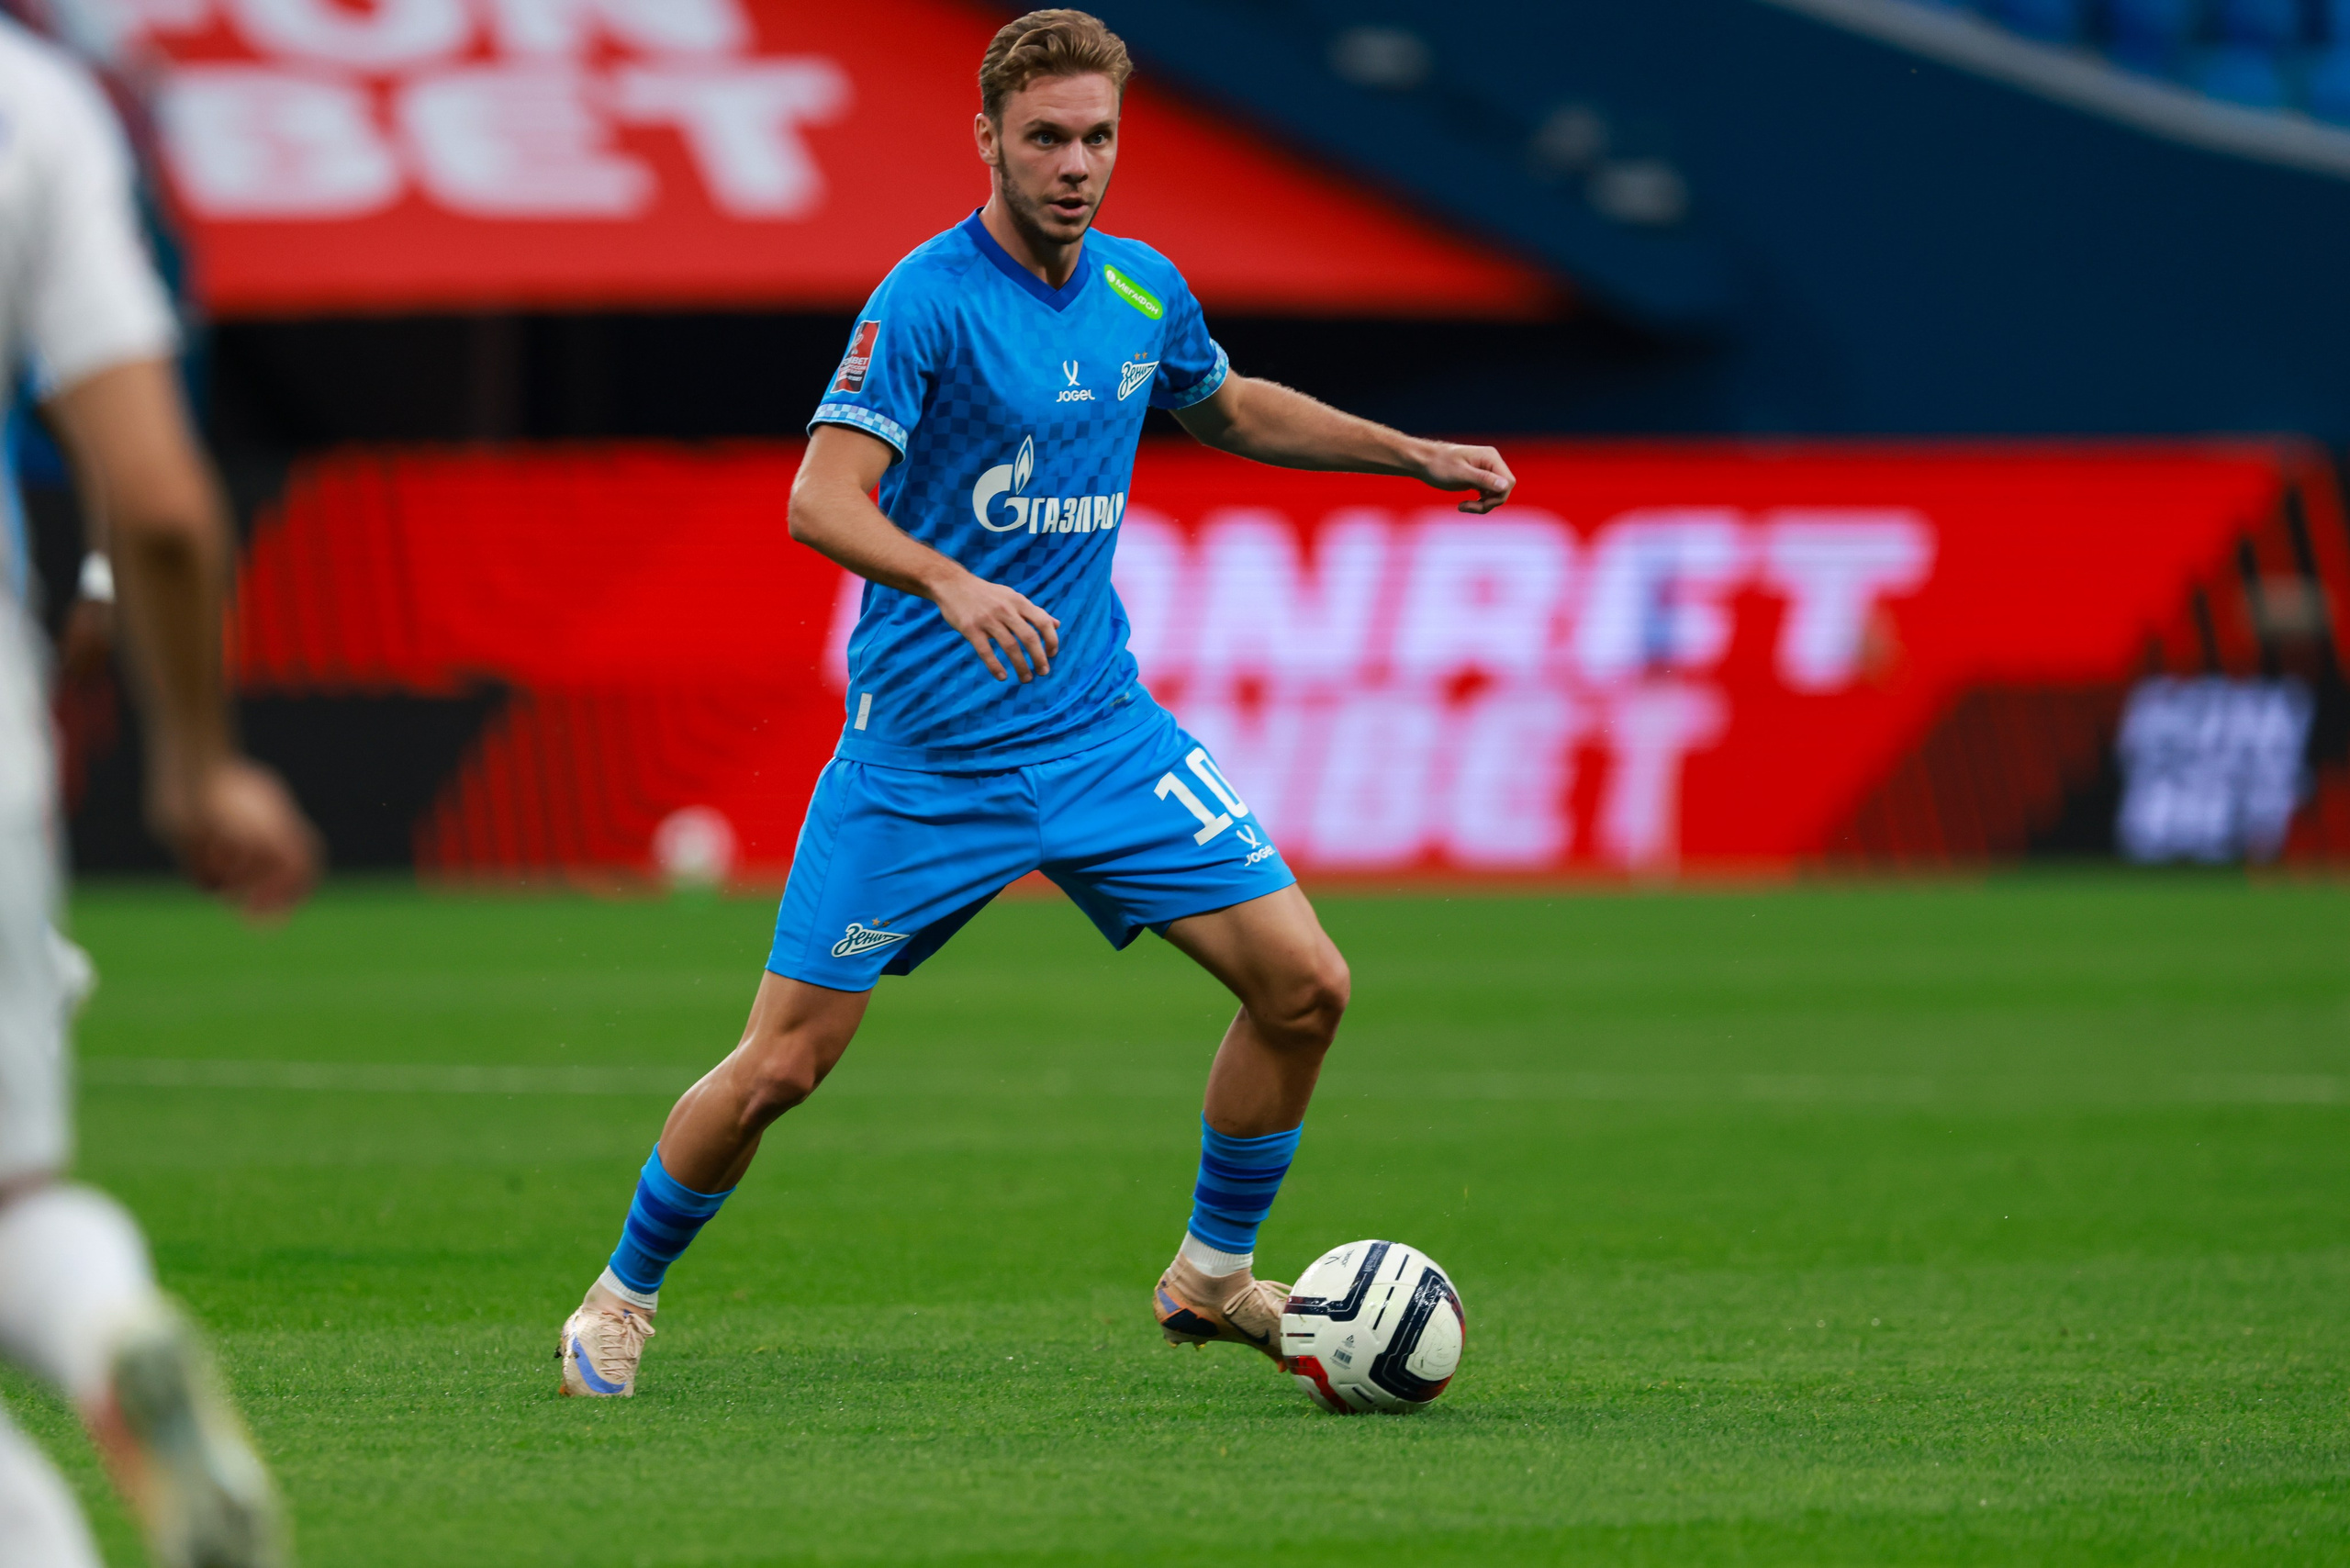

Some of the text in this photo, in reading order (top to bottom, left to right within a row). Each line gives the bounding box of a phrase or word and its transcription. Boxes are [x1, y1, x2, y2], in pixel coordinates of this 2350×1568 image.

[1114, 279, 1159, 315] МЕГАФОН
[1056, 389, 1096, 403] JOGEL
[1153, 746, 1249, 847] 10
